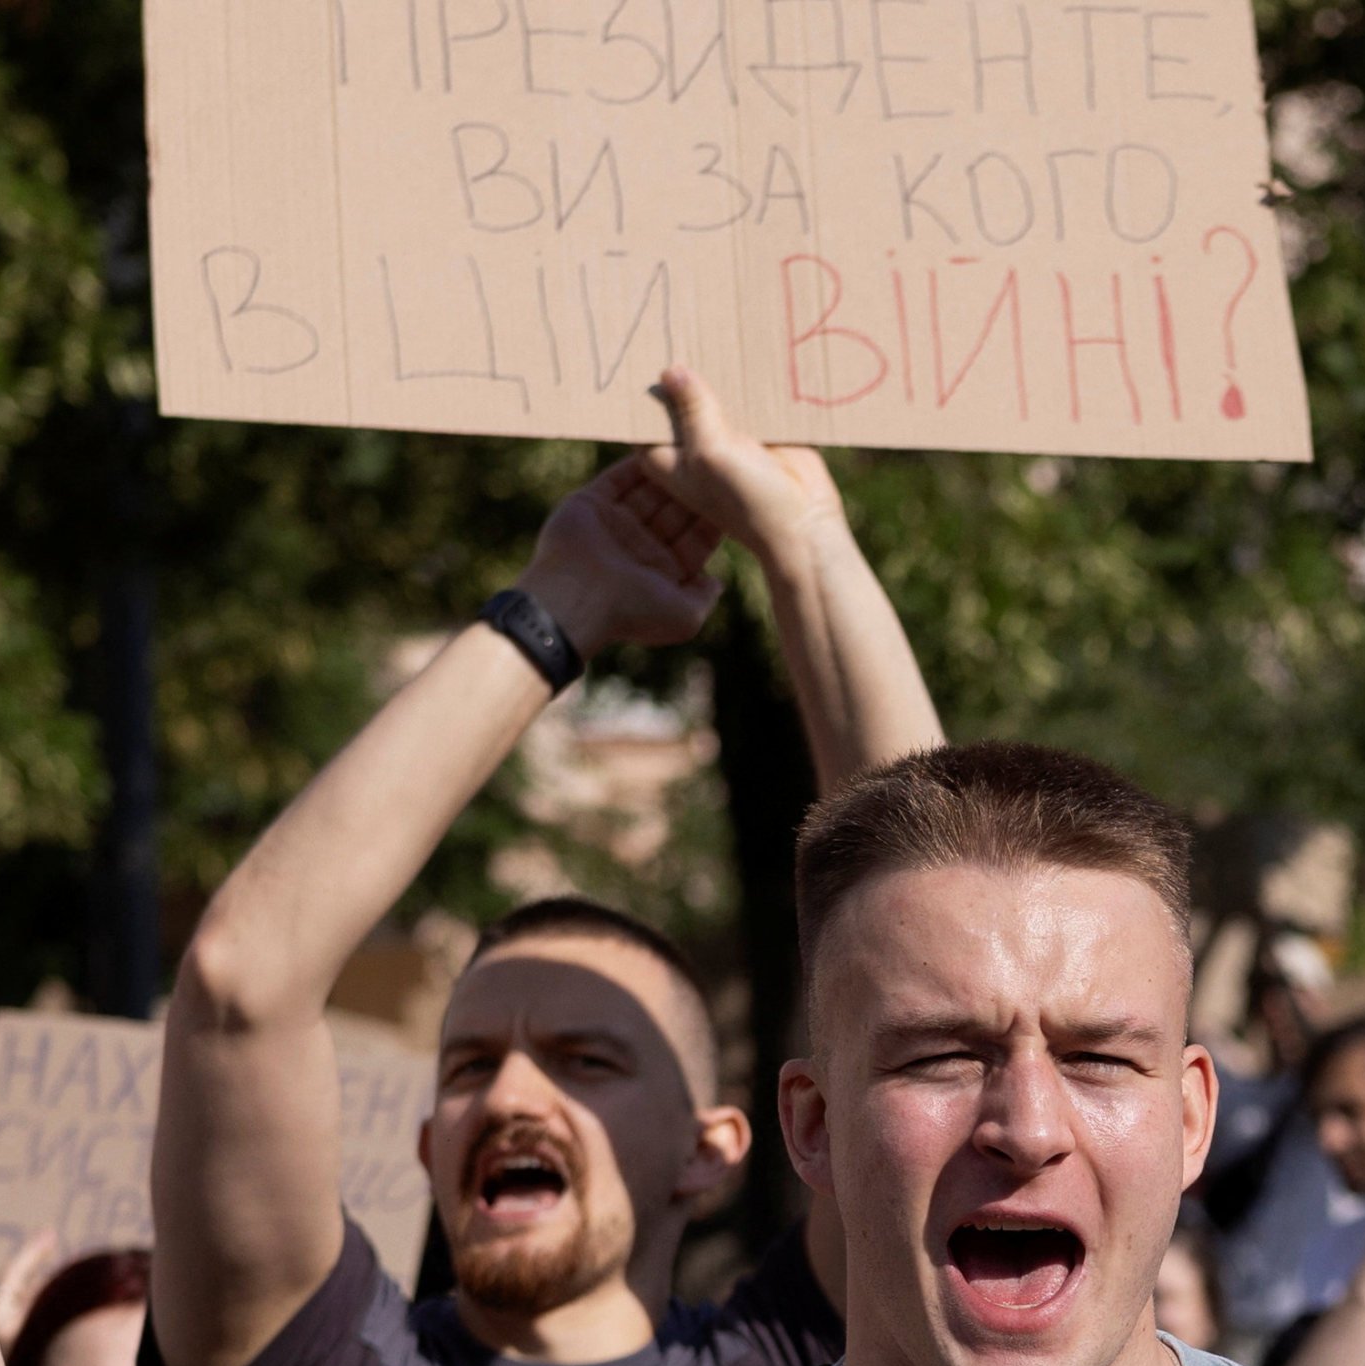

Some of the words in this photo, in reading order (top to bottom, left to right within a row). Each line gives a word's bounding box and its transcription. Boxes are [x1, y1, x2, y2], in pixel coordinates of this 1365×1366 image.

[451, 121, 625, 236] ВИ
[677, 140, 813, 235] ЗА
[892, 142, 1180, 248] КОГО
[199, 244, 322, 377] В
[377, 248, 677, 415] ЦІЙ
[778, 224, 1260, 424] ВІЙНІ?
